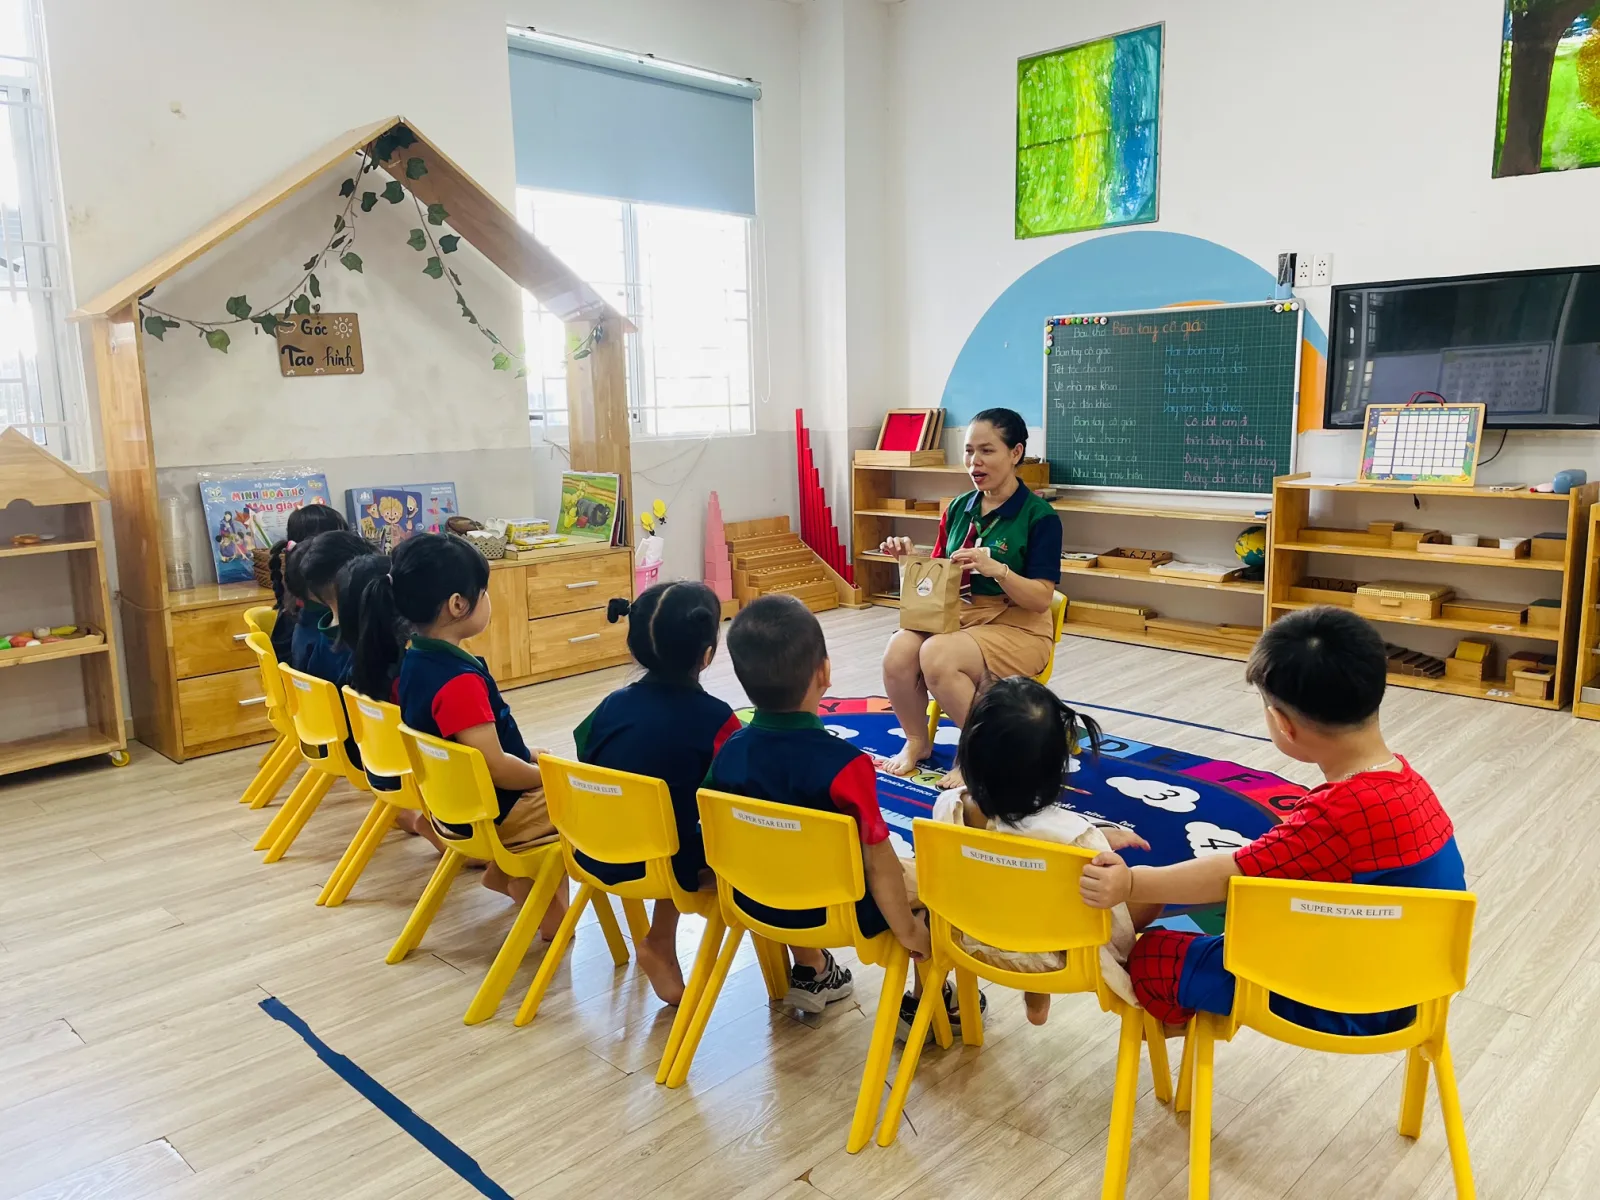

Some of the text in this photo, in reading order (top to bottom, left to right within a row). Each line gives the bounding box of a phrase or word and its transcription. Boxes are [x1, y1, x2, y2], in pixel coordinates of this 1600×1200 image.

[301, 318, 328, 335] Góc
[1138, 323, 1158, 343] tay
[1163, 321, 1176, 333] cô
[322, 345, 355, 367] hình
[232, 491, 259, 501] MINH
[818, 702, 841, 713] Y
[1217, 772, 1265, 783] F
[904, 785, 933, 797] Lemon
[1143, 789, 1181, 801] 3
[738, 812, 796, 829] SUPER STAR ELITE
[1200, 838, 1242, 850] 4
[970, 851, 1044, 869] SUPER STAR ELITE
[1300, 903, 1395, 917] SUPER STAR ELITE
